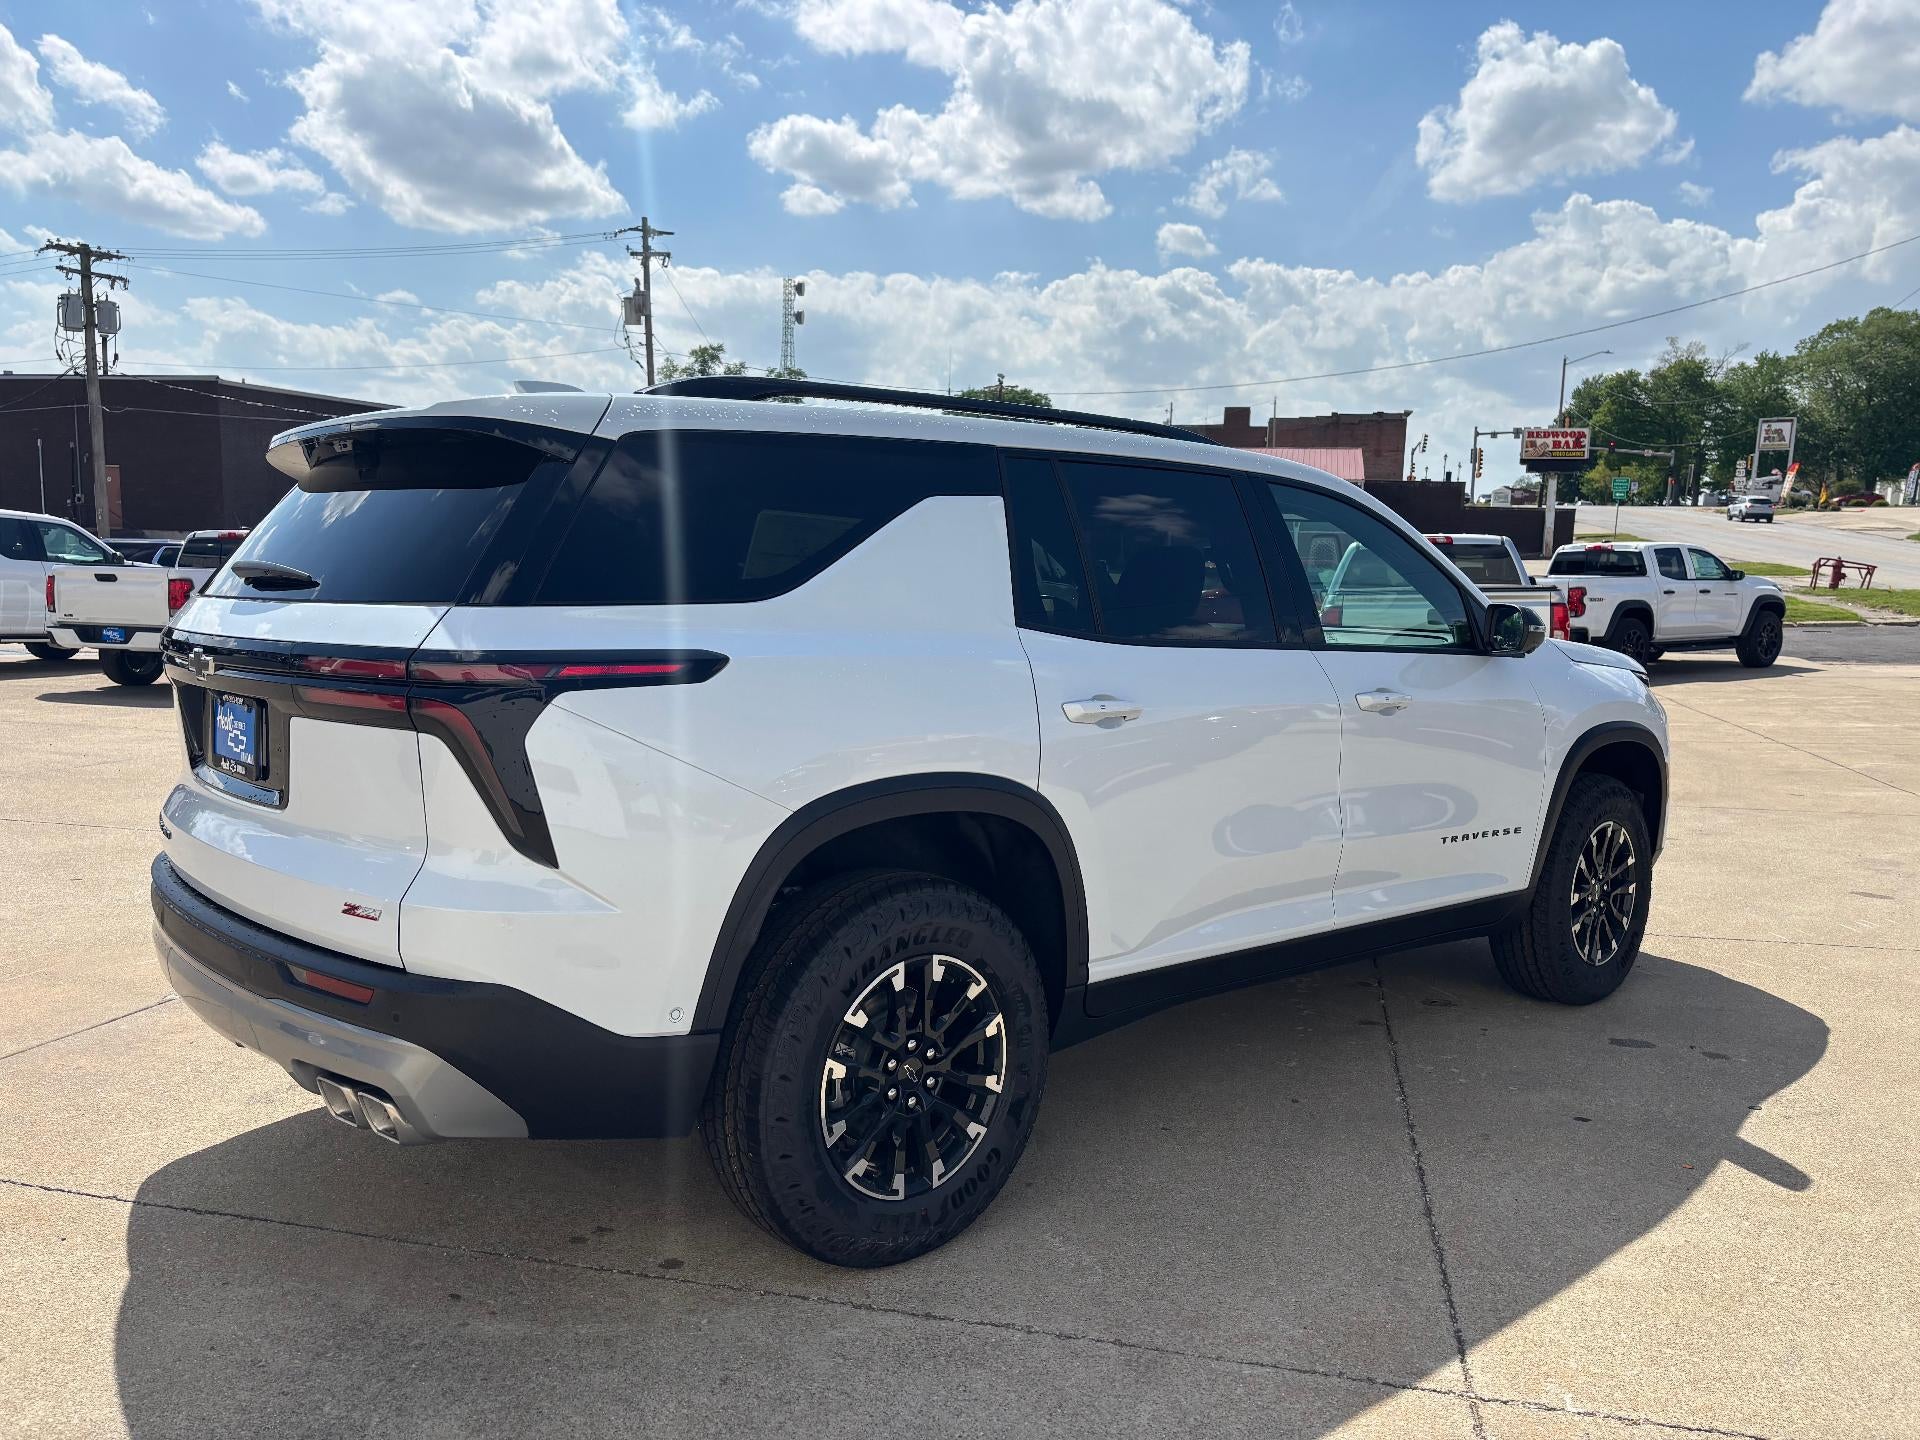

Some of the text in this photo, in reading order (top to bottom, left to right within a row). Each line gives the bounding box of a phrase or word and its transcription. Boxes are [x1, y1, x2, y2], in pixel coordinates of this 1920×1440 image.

[1552, 440, 1584, 449] BAR
[1441, 827, 1522, 844] TRAVERSE
[840, 925, 973, 998] WRANGLER
